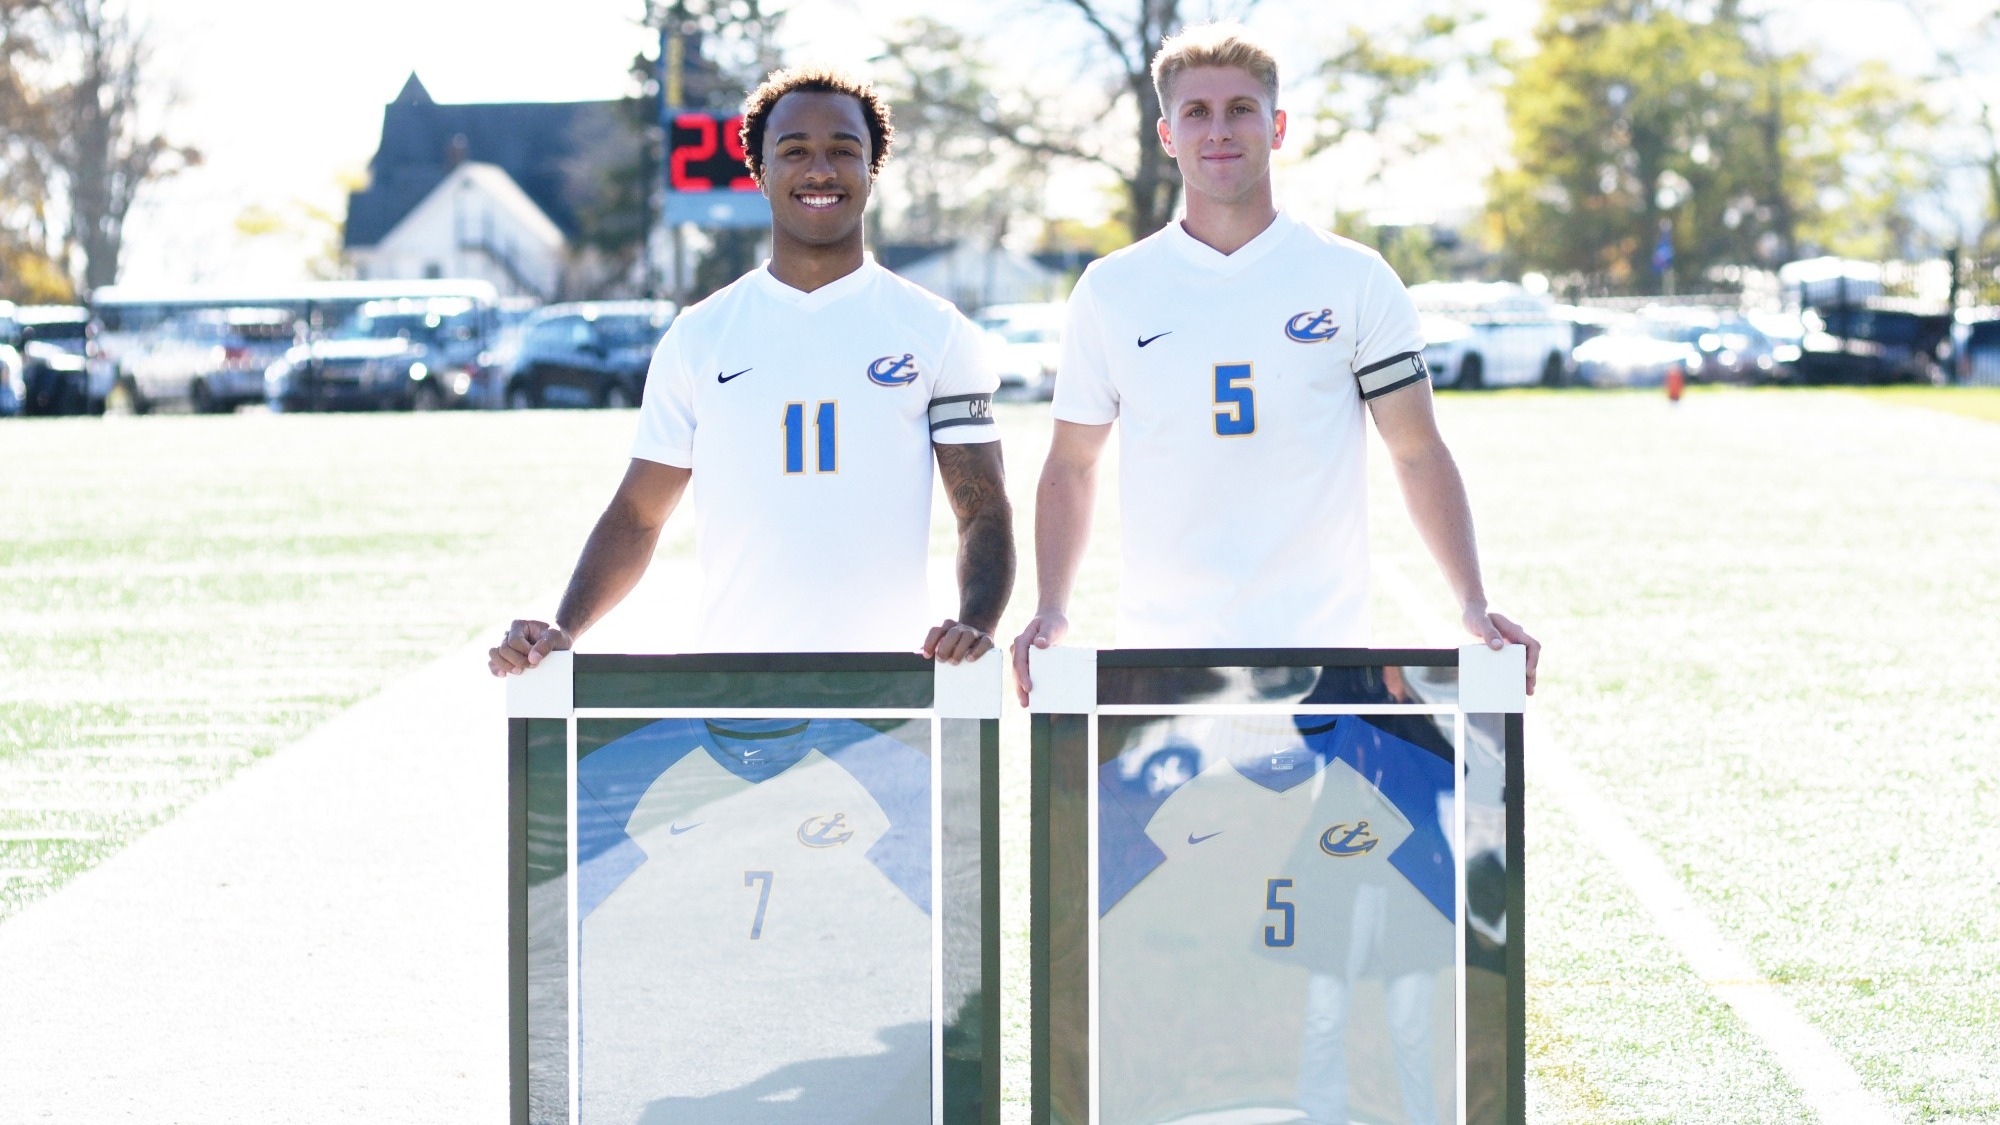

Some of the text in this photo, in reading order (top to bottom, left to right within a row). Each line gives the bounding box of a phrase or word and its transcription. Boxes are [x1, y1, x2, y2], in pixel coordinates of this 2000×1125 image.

[1212, 361, 1258, 438] 5
[781, 400, 839, 475] 11
[743, 869, 774, 941] 7
[1264, 878, 1296, 949] 5
